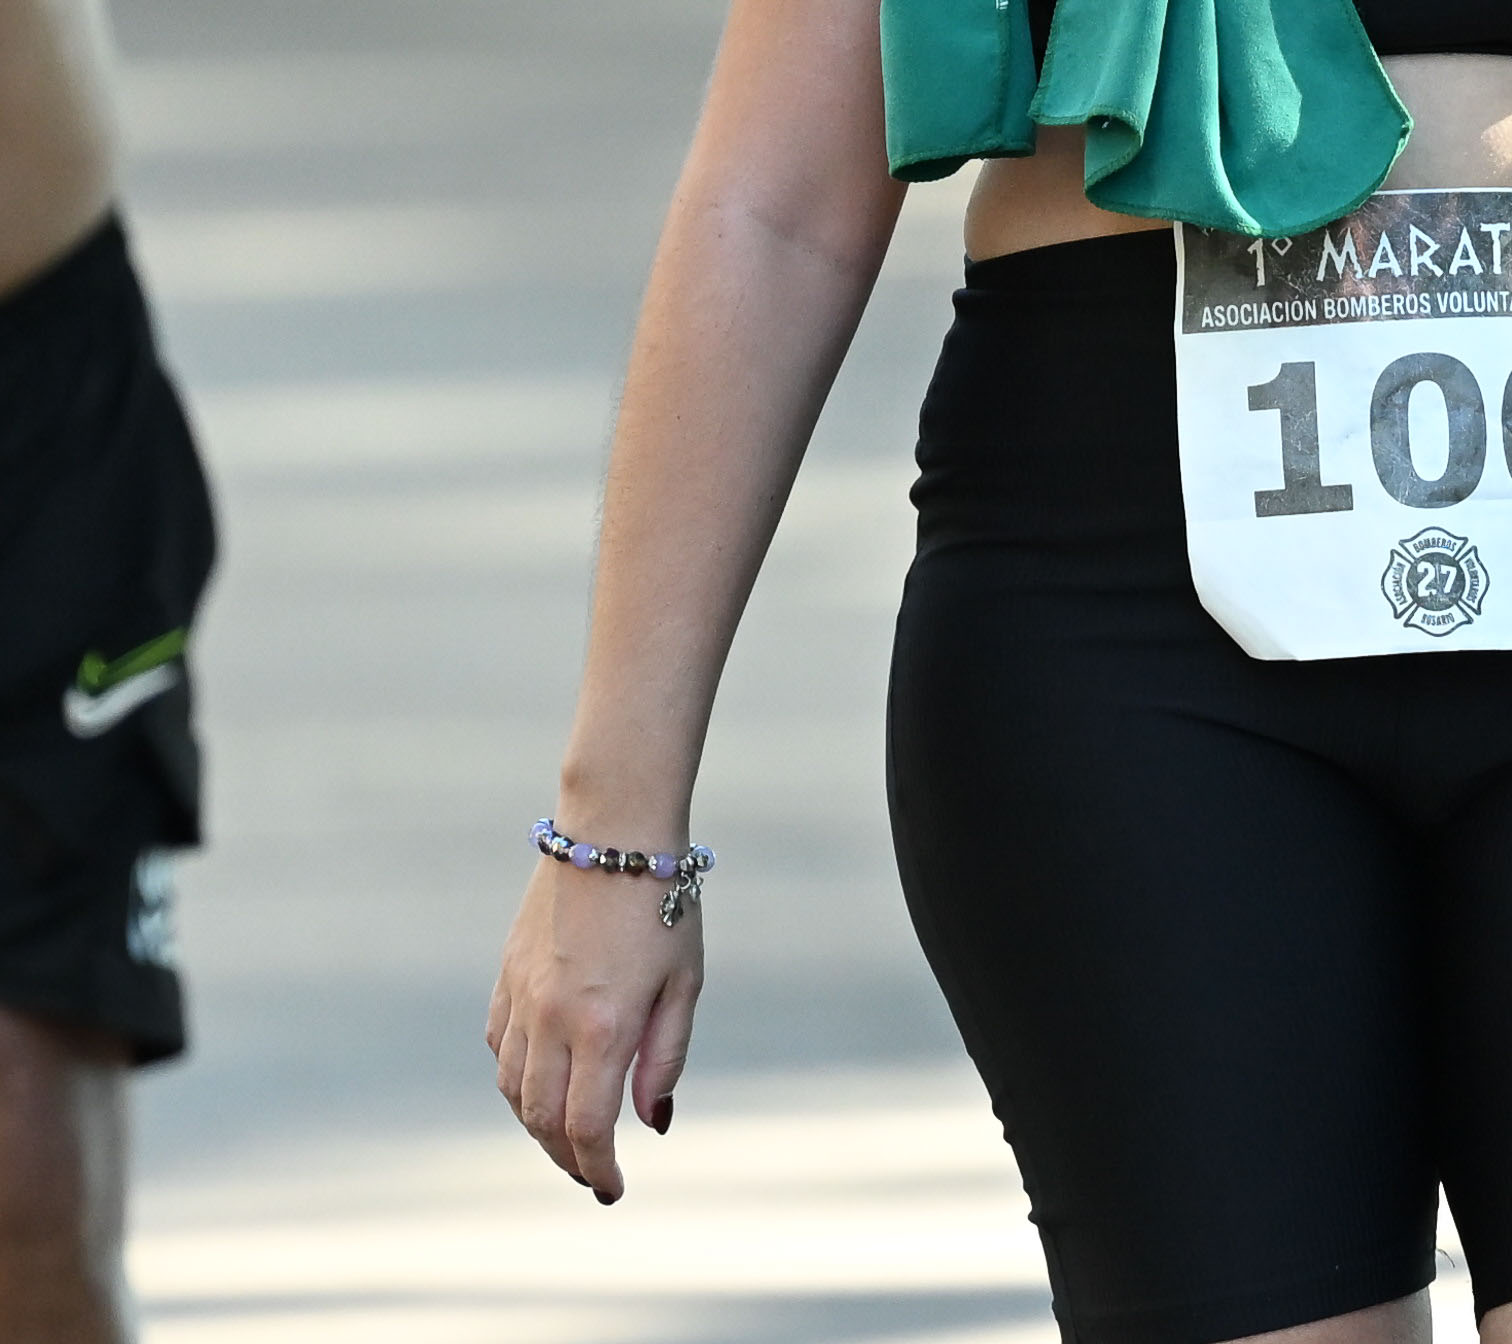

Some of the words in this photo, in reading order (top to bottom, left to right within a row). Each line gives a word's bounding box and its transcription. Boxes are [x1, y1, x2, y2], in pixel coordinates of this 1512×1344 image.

[1201, 294, 1318, 328] ASOCIACIÓN
[1324, 292, 1431, 319] BOMBEROS
[1416, 560, 1458, 598] 27
